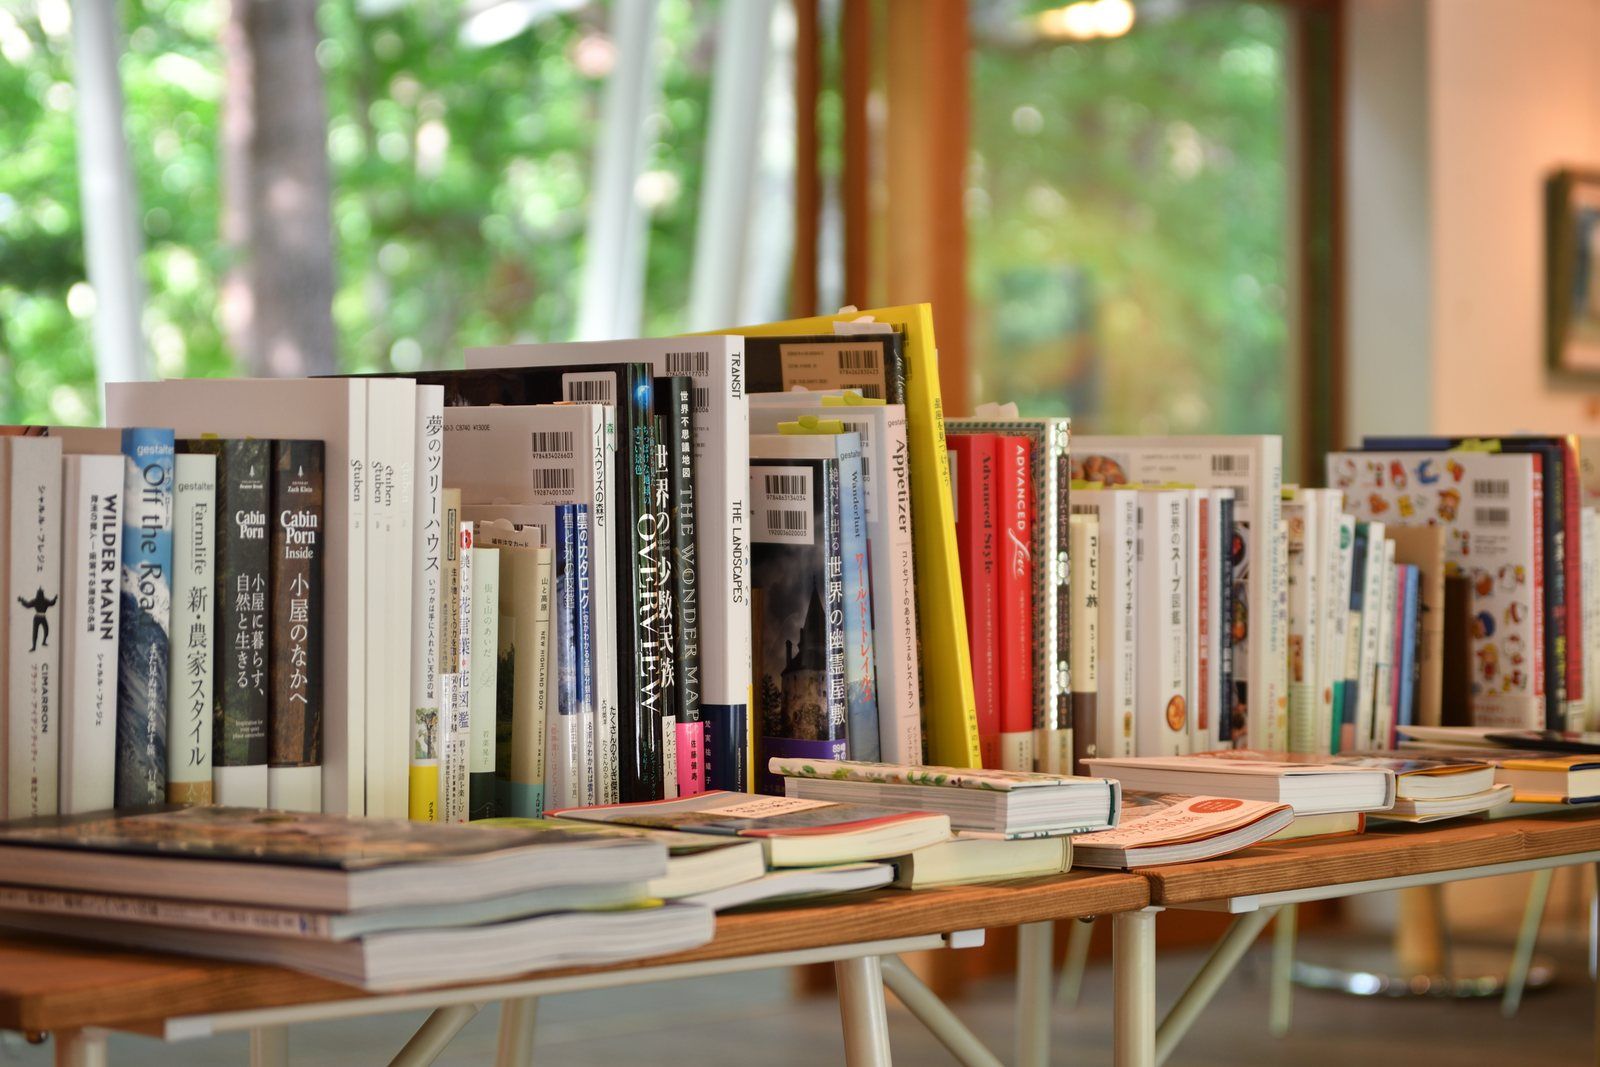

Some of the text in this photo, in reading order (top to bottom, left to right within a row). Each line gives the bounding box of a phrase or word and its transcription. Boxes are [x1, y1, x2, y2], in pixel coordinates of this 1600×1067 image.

[731, 352, 741, 400] TRANSIT
[532, 452, 574, 460] 9784834026603
[594, 423, 604, 527] ノースウッズの森で
[606, 423, 614, 452] 森へ
[680, 390, 691, 478] 世界不思議地図
[235, 510, 266, 525] Cabin
[280, 510, 318, 528] Cabin
[351, 459, 364, 502] Stuben
[372, 461, 385, 504] Stuben
[425, 415, 443, 571] 夢のツリーハウス
[680, 485, 694, 536] THE
[850, 471, 860, 539] Wanderlust
[892, 439, 909, 533] Appetizer
[982, 455, 992, 529] Advanced
[1016, 444, 1026, 531] ADVANCED
[1059, 457, 1068, 548] ウィリアム・モリス
[100, 494, 117, 640] WILDER MANN
[139, 463, 165, 618] Off the Roa
[194, 503, 208, 575] Farmlife
[240, 524, 264, 539] Porn
[285, 527, 316, 544] Porn
[285, 546, 314, 559] Inside
[562, 513, 575, 609] 雪と氷の図鑑
[576, 512, 590, 610] 雲のカタログ
[655, 444, 675, 688] 世界の少数民族
[732, 500, 743, 604] THE LANDSCAPES
[984, 533, 993, 574] Style
[1008, 528, 1031, 580] Love
[1086, 536, 1099, 608] コーヒーと旅
[1123, 501, 1133, 642] 世界のサンドイッチ図鑑
[1170, 500, 1182, 626] 世界のスープ図鑑
[235, 572, 250, 689] 自然と生きる
[251, 572, 265, 696] 小屋に暮らす、
[289, 572, 309, 704] 小屋のなかへ
[426, 579, 436, 699] いつかは手に入れたい天空の城
[483, 583, 494, 658] 街と山のあいだ
[540, 577, 549, 612] 山と高原
[637, 513, 661, 713] OVERVIEW
[681, 543, 698, 661] WONDER
[187, 586, 208, 767] 新・農家スタイル
[458, 554, 471, 729] 美しい花言葉 花図鑑
[828, 555, 846, 726] 世界の幽霊屋敷
[609, 706, 618, 804] たくさんのふしぎ傑作
[426, 801, 434, 822] グラフ
